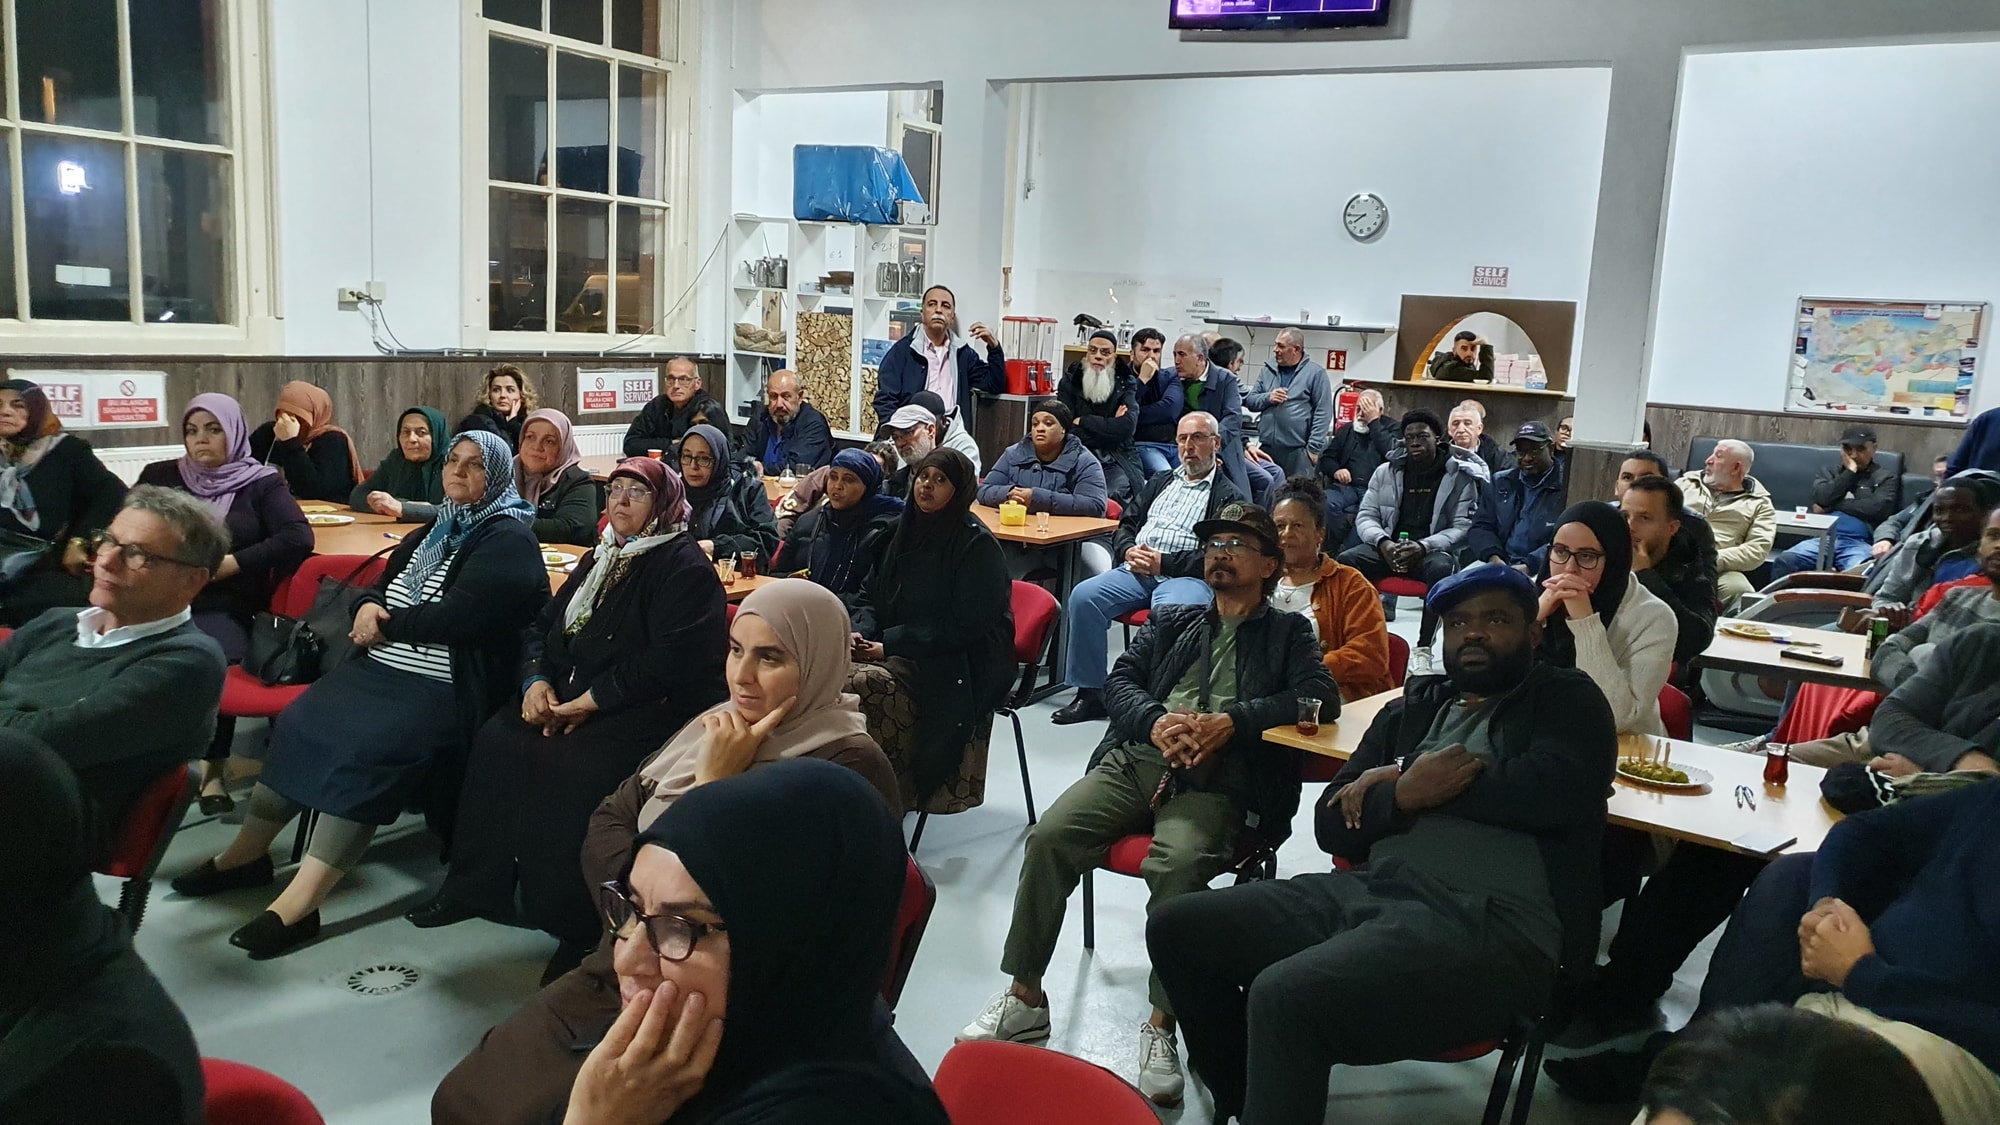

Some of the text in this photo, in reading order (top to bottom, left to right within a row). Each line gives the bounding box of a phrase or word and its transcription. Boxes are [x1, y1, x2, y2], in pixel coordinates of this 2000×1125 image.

[1476, 267, 1507, 277] SELF
[1474, 276, 1507, 286] SERVICE
[625, 380, 651, 391] SELF
[42, 385, 79, 400] ELF
[624, 391, 652, 402] SERVICE
[50, 401, 81, 415] VICE
